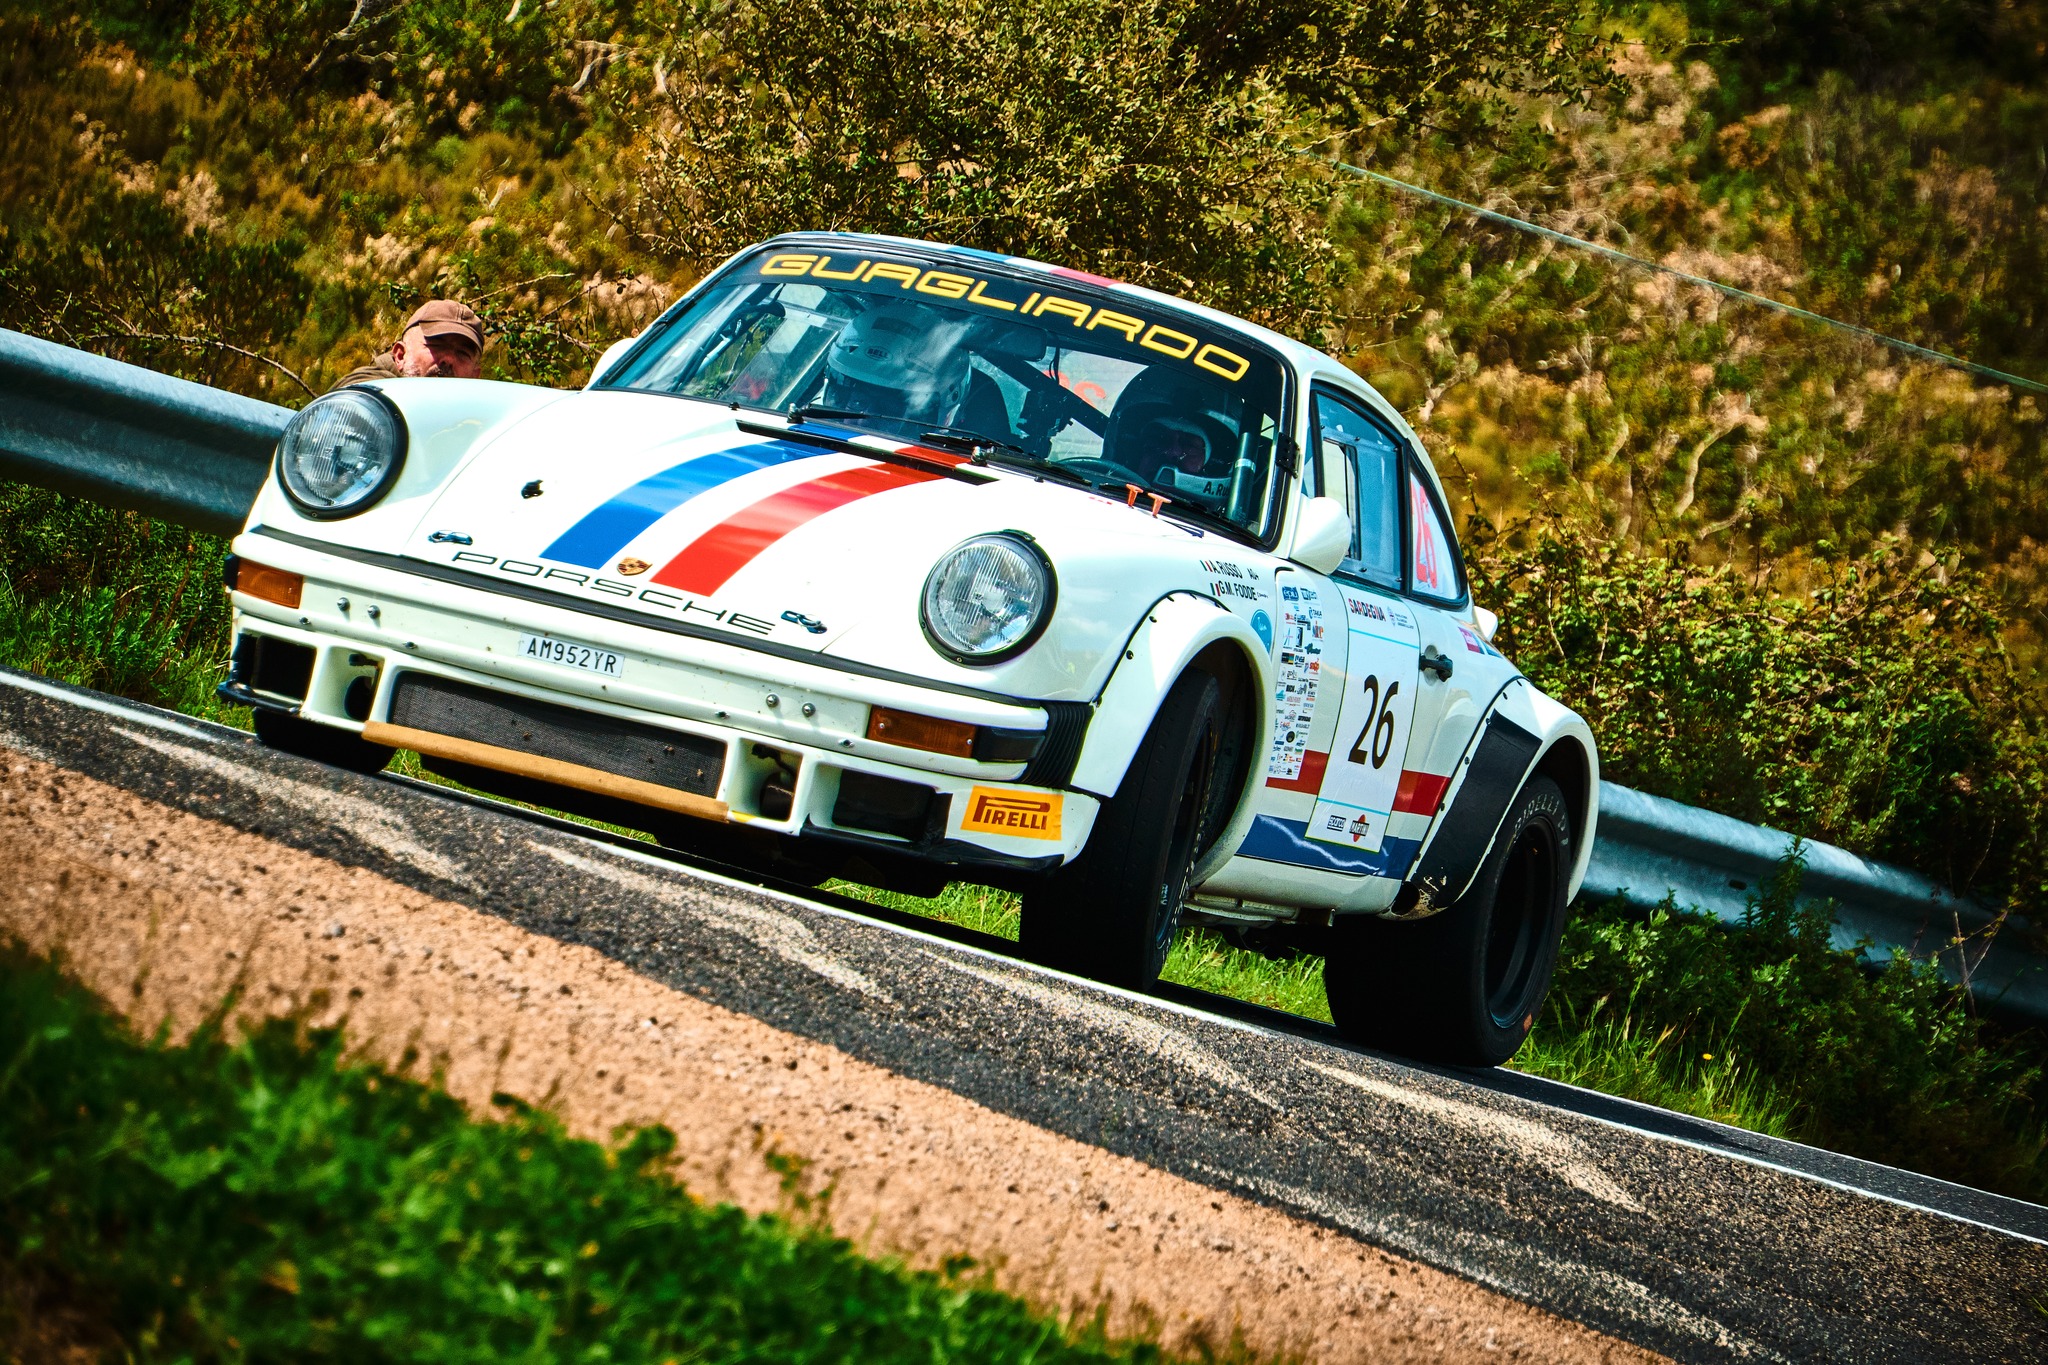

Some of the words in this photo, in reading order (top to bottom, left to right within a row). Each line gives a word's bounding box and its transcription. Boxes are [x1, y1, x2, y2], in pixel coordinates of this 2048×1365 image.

[760, 254, 1251, 382] GUAGLIARDO
[867, 348, 889, 358] BELL
[451, 551, 777, 636] PORSCHE
[1233, 583, 1258, 601] FODDE
[1348, 598, 1387, 622] SARDEGNA
[526, 637, 617, 674] AM952YR
[1347, 674, 1399, 770] 26
[972, 795, 1051, 830] PIRELLI
